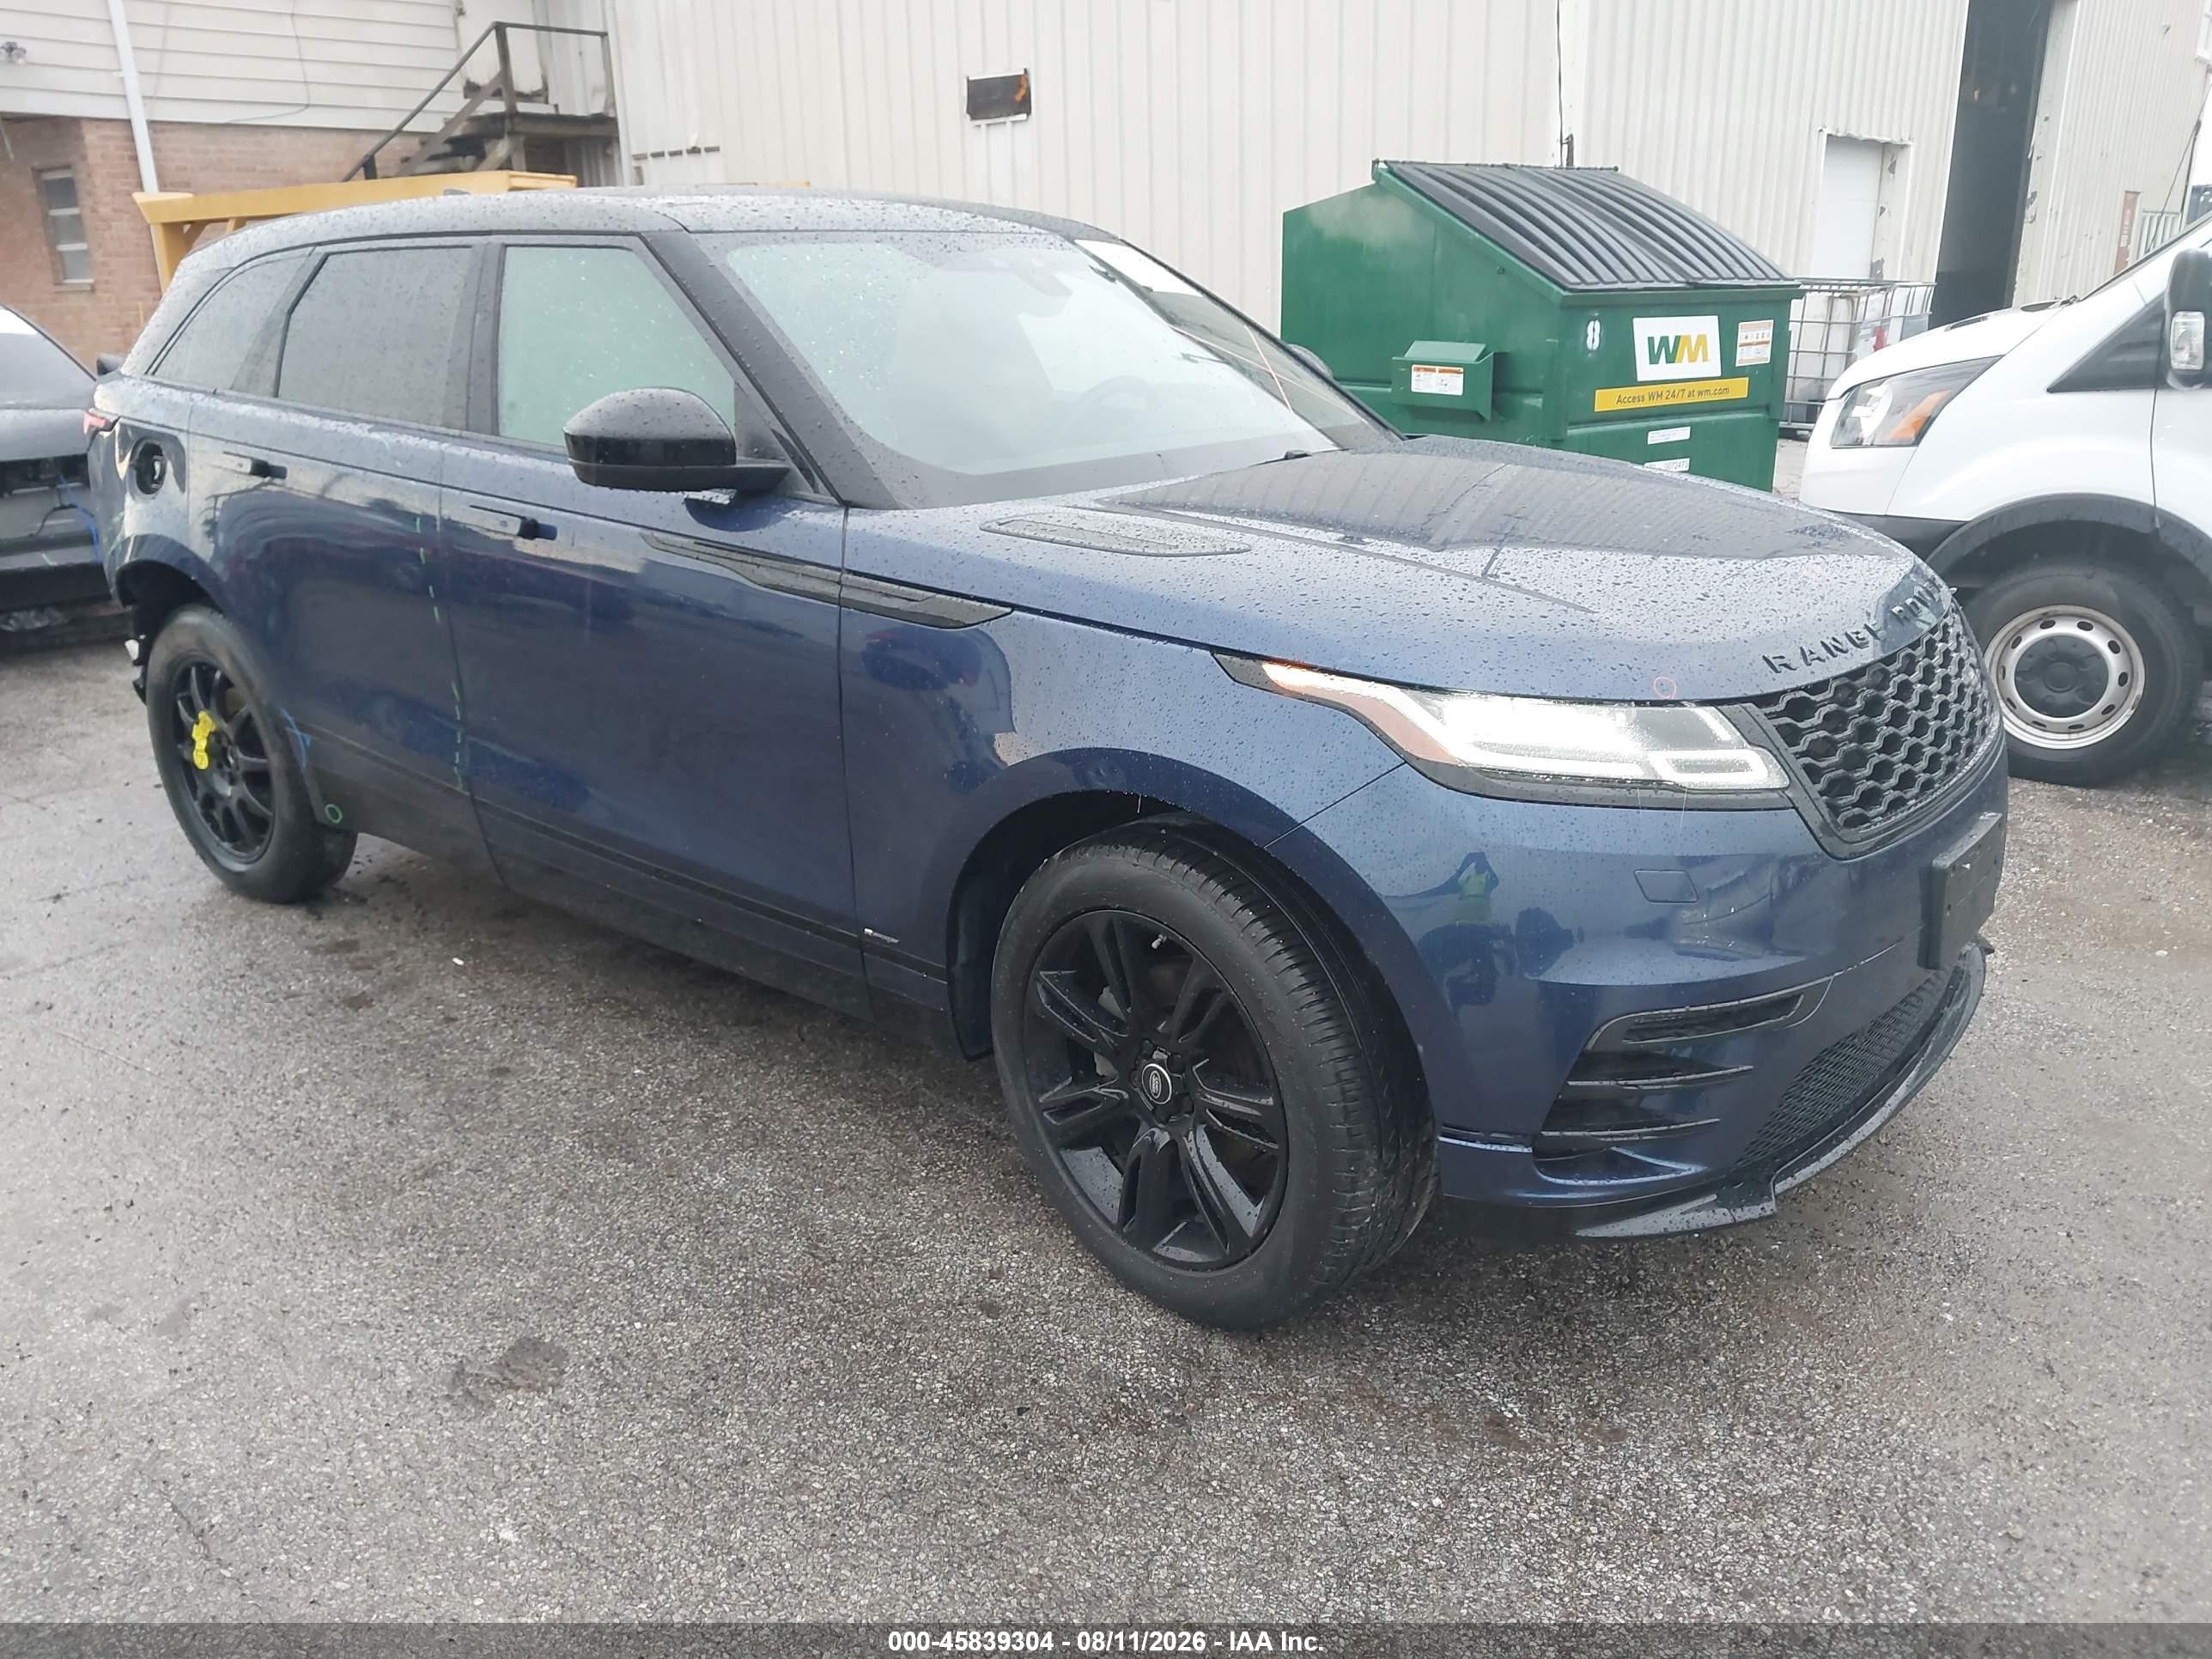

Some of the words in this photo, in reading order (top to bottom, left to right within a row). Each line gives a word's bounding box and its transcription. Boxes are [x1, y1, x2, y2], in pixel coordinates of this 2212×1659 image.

[1648, 334, 1709, 365] WM
[1616, 394, 1645, 405] Access
[1648, 391, 1663, 401] WM
[1666, 388, 1686, 400] 24/7
[1687, 389, 1695, 398] at
[1697, 386, 1730, 398] wm.com
[1761, 618, 1887, 674] RANGE
